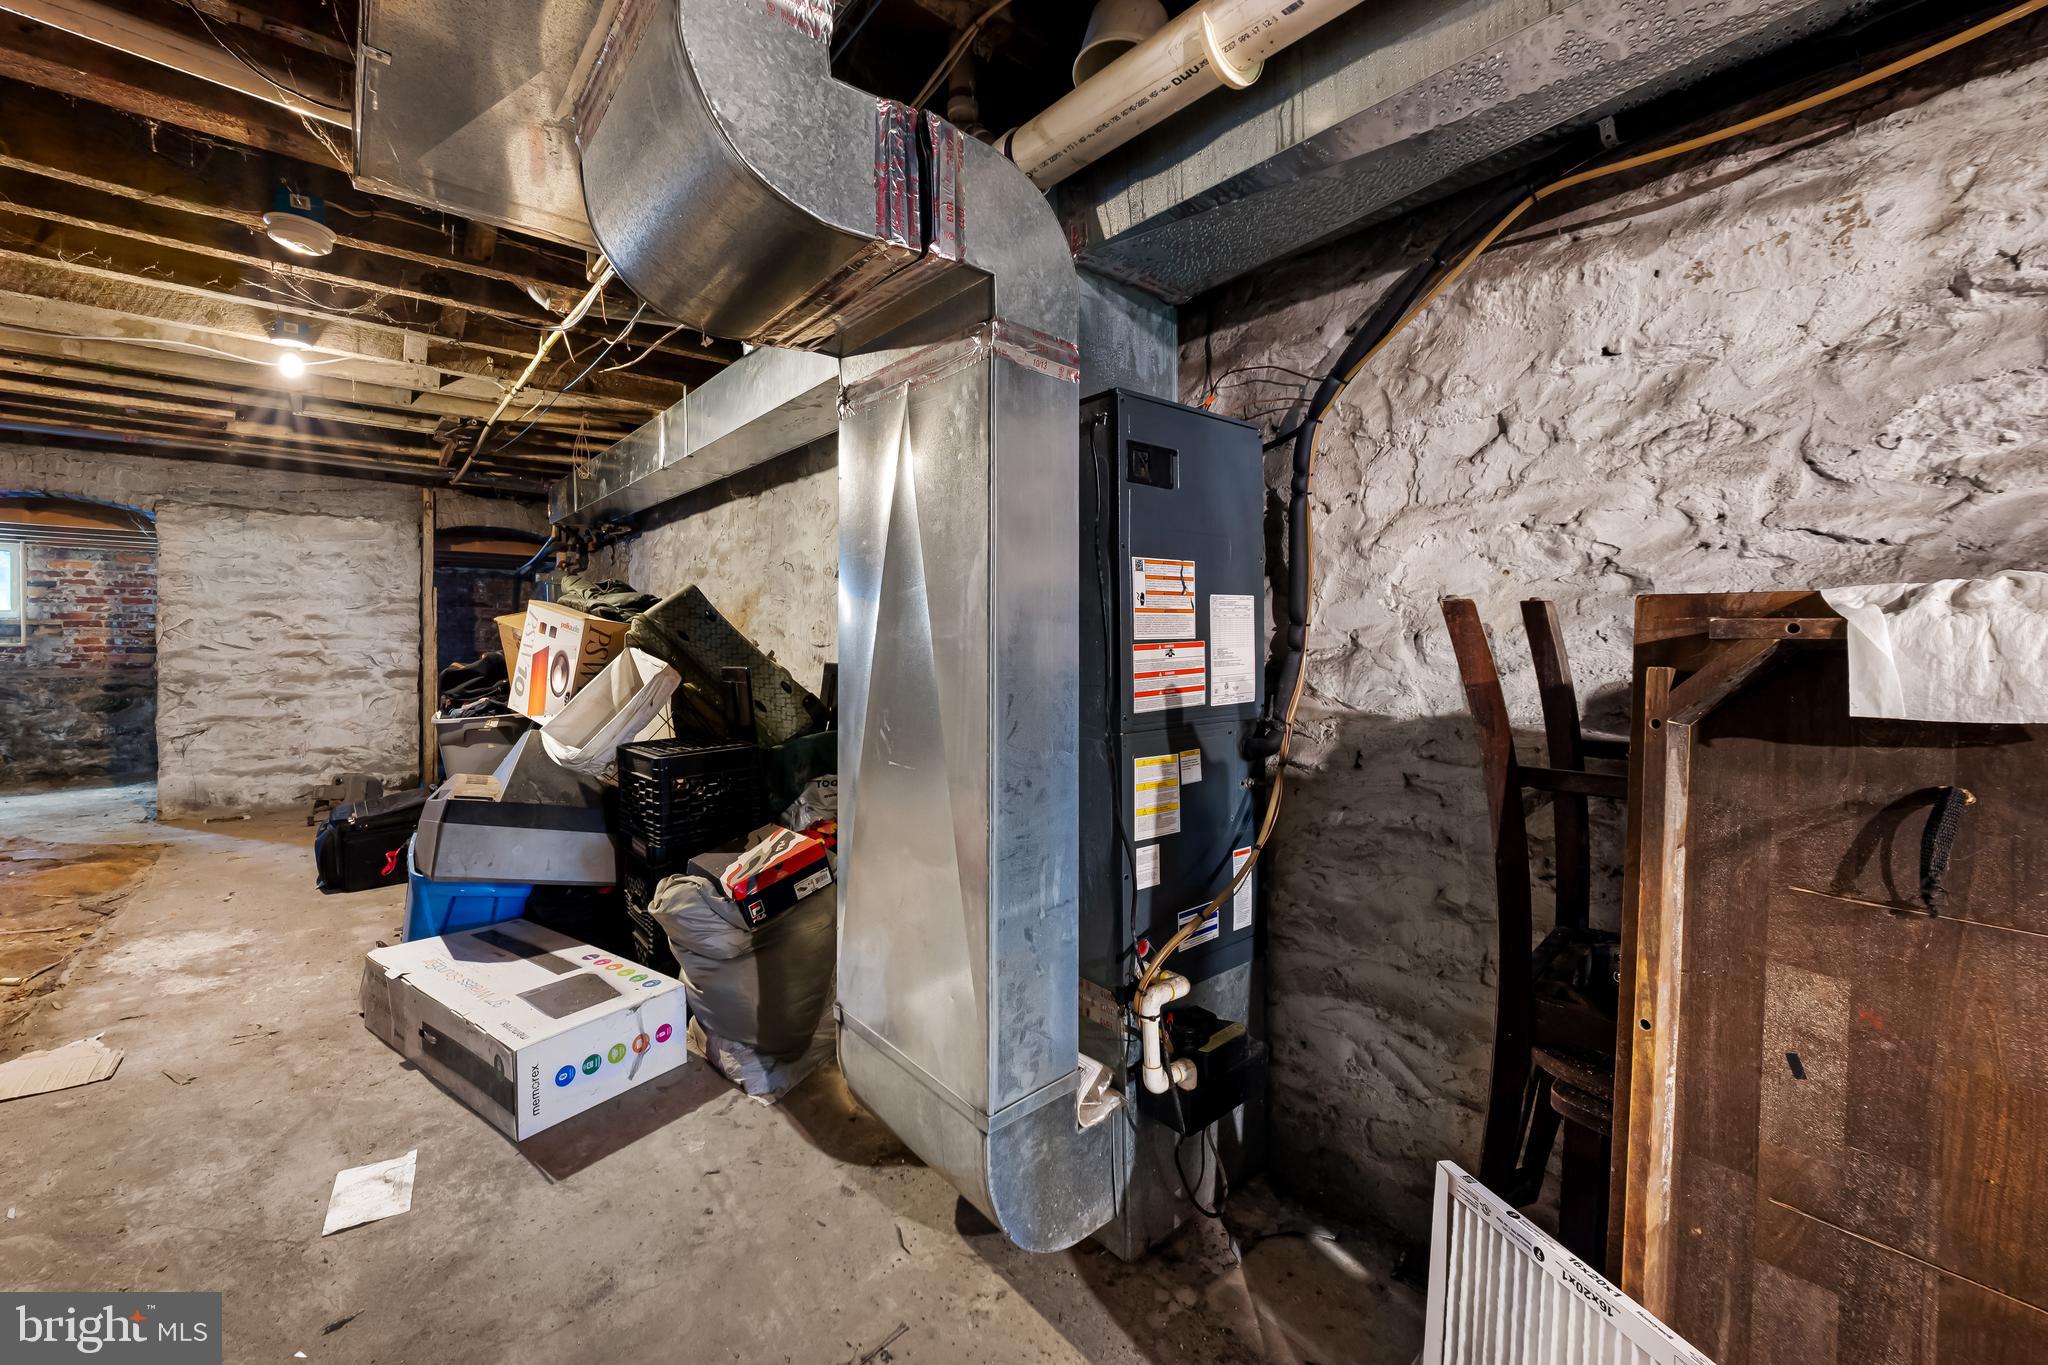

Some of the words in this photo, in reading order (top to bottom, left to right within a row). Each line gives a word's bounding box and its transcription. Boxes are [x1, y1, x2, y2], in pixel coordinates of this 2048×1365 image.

[1032, 358, 1048, 370] 10/13
[531, 1063, 541, 1117] memorex
[1562, 1270, 1614, 1318] 16x20x1
[1568, 1256, 1622, 1298] 16x20x1
